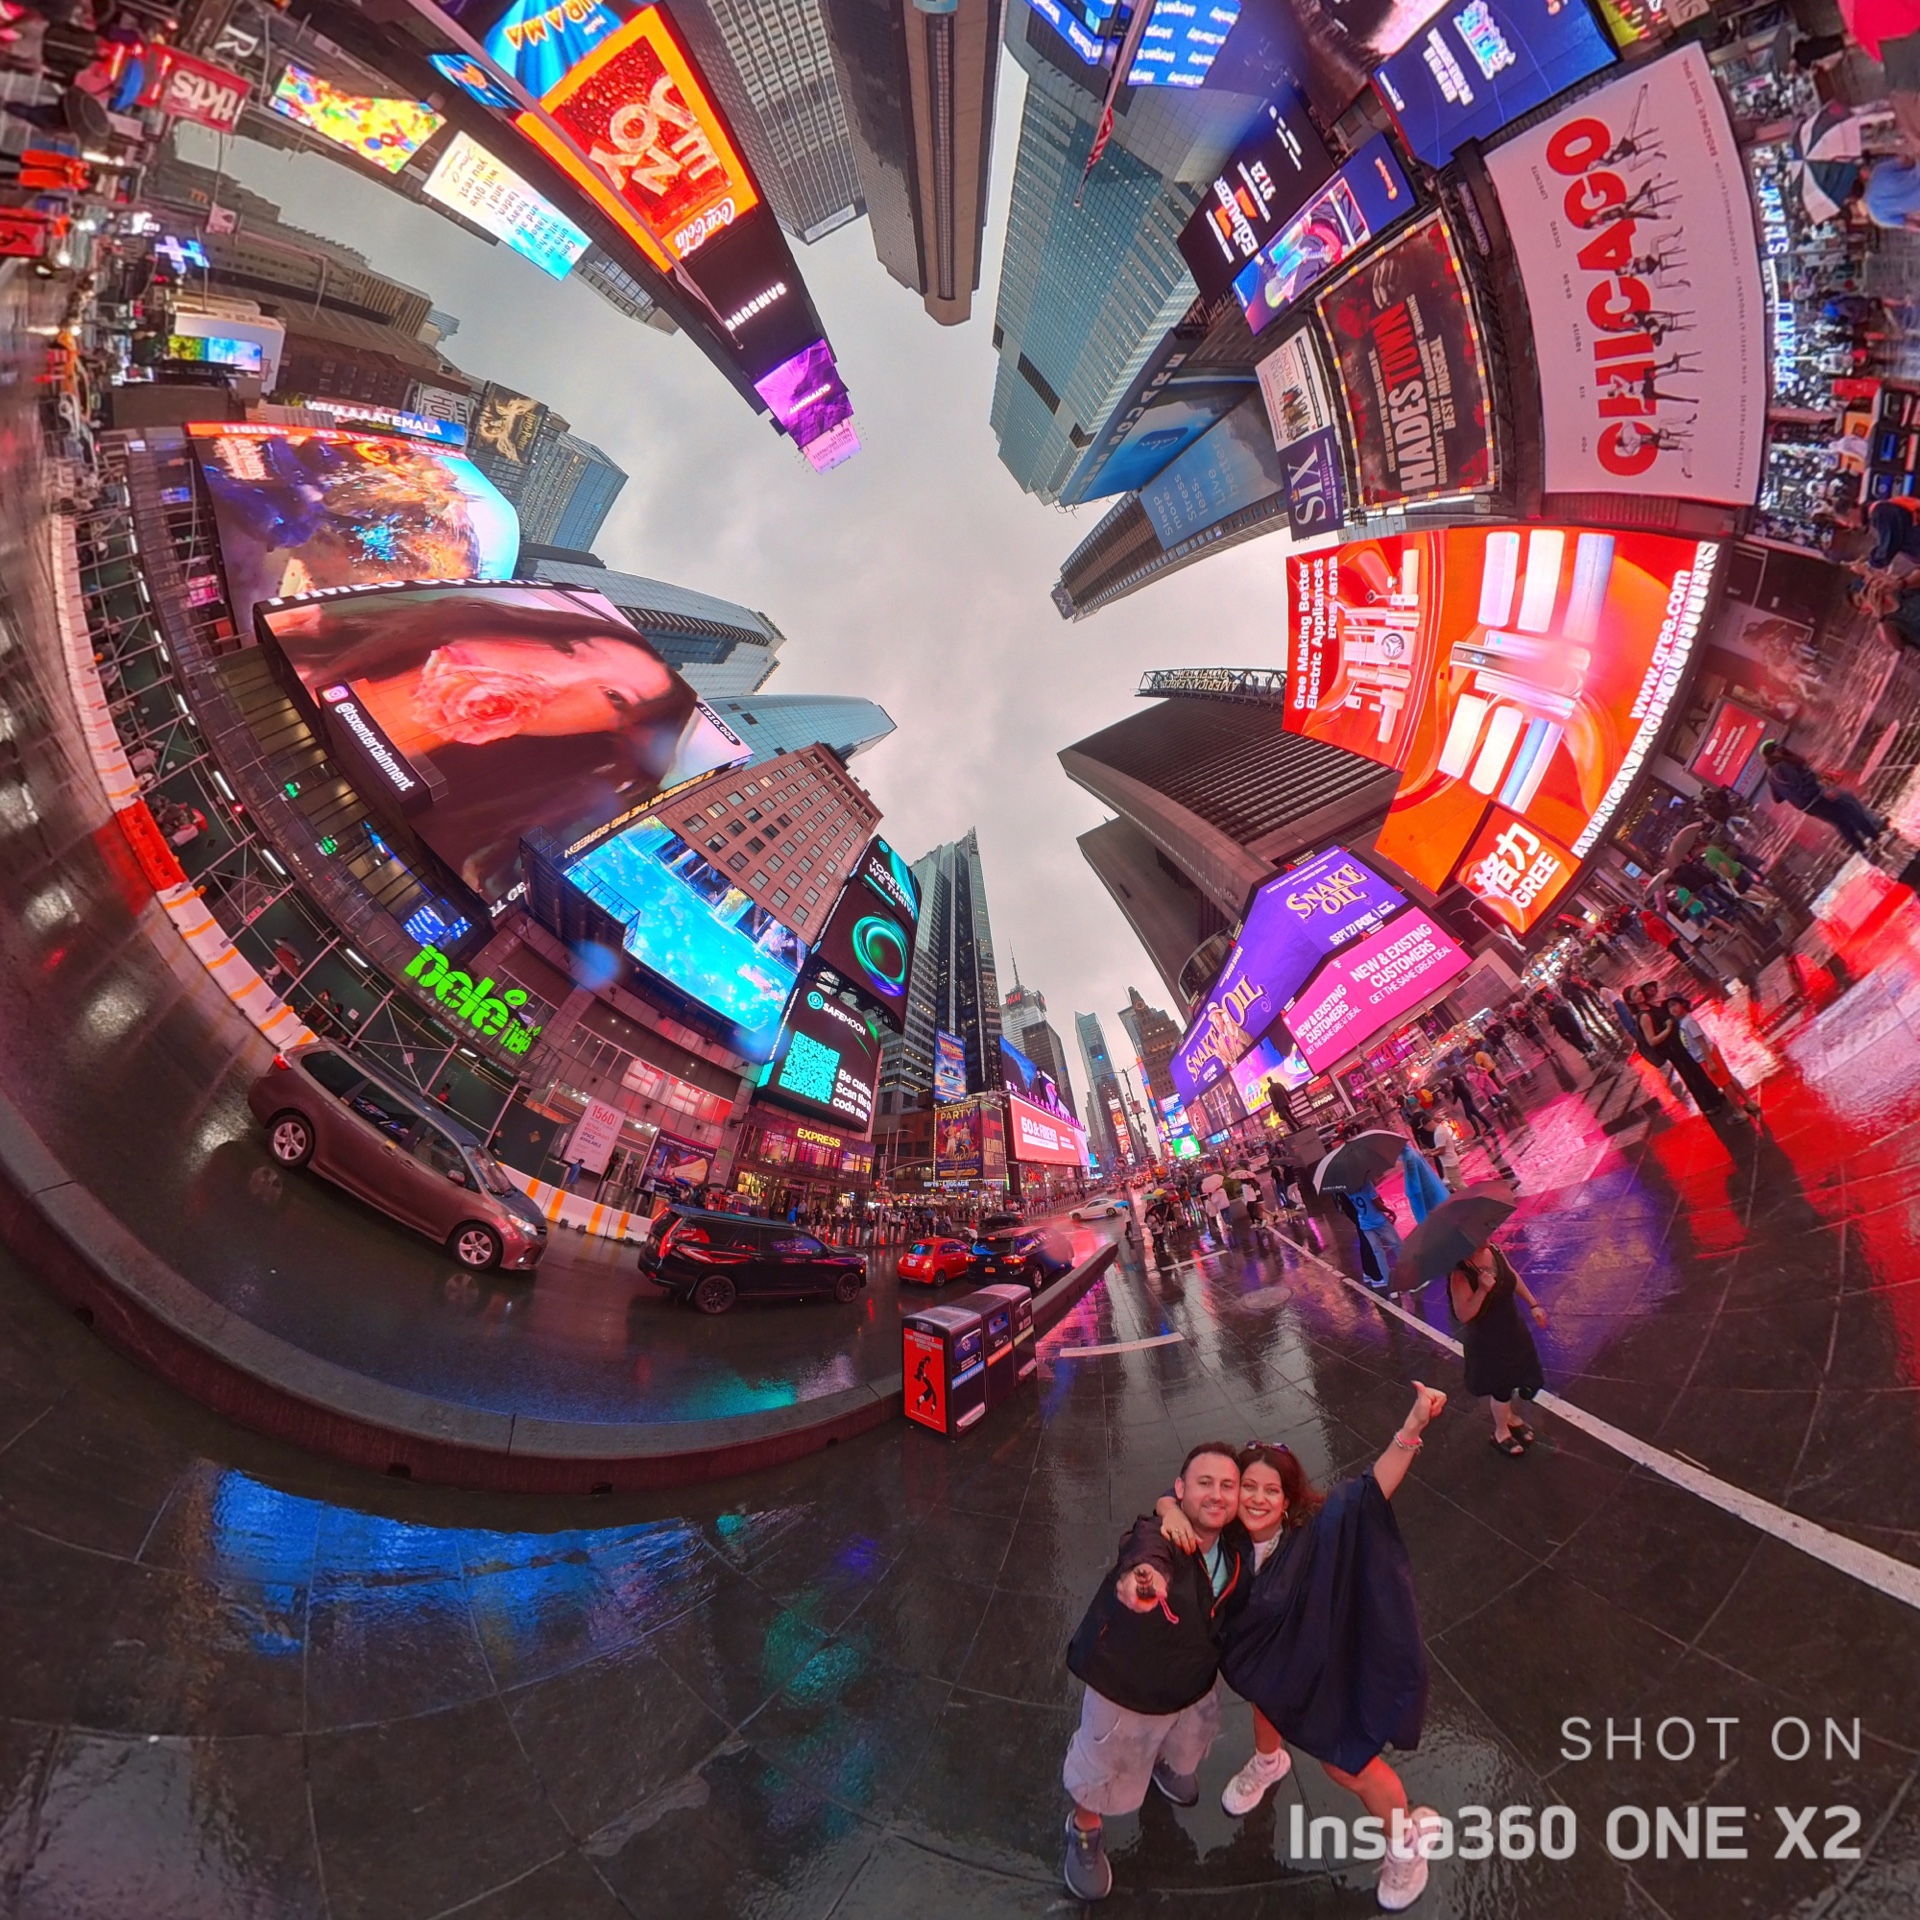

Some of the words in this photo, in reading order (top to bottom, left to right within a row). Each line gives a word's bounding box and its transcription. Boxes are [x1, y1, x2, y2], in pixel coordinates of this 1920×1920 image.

[170, 71, 240, 122] tkts
[589, 74, 699, 191] JOY
[472, 157, 488, 177] you
[483, 170, 499, 188] will
[631, 124, 721, 197] EN
[457, 178, 475, 199] rest.
[470, 187, 487, 207] give
[490, 184, 506, 205] and
[506, 200, 530, 225] heavy
[515, 222, 529, 236] are
[527, 204, 540, 223] and
[528, 217, 549, 239] labor
[549, 222, 559, 236] all
[1213, 176, 1259, 257] EQUALIZER
[725, 282, 787, 332] SAMSUNG
[1546, 117, 1659, 477] CHICAGO
[1429, 334, 1451, 397] MUSICAL
[1370, 302, 1437, 492] HADESTOWN
[1430, 401, 1442, 426] TONY
[1440, 398, 1456, 431] BEST
[1433, 425, 1448, 485] BROADWAY'S
[1175, 474, 1196, 521] Stress
[1192, 478, 1208, 516] less.
[1209, 468, 1226, 505] Live
[1287, 446, 1326, 526] SIX
[1154, 496, 1173, 536] Sleep
[1163, 487, 1182, 530] more.
[1298, 562, 1311, 612] Better
[1311, 558, 1326, 648] Appliances
[1297, 615, 1313, 672] Making
[1629, 569, 1693, 720] www.gree.com
[1293, 675, 1307, 710] Gree
[1306, 651, 1323, 710] Electric
[1570, 754, 1640, 858] AMERICAN
[1630, 696, 1671, 758] EAGLE
[1661, 540, 1721, 696] OUTFITTERS
[335, 702, 415, 792] @tsxentertainment
[610, 812, 631, 829] BIG
[630, 803, 650, 819] THE
[564, 824, 610, 859] SCREEN
[1474, 823, 1540, 899] 格力
[869, 864, 885, 884] WE
[885, 882, 916, 920] THRIVE
[871, 857, 916, 907] TOGETHER
[1286, 863, 1368, 920] SNAKE
[1321, 887, 1368, 915] OIL
[1511, 851, 1561, 909] GREE
[1329, 929, 1350, 945] SEPT
[1353, 912, 1379, 930] FOX
[1349, 957, 1381, 982] NEW
[1377, 953, 1391, 965] &
[1384, 923, 1433, 960] EXISTING
[1369, 990, 1385, 1004] GET
[1383, 980, 1401, 995] THE
[1396, 971, 1418, 987] SAME
[1414, 956, 1436, 974] GREAT
[1434, 945, 1453, 961] DEAL
[1370, 939, 1437, 988] CUSTOMERS
[822, 1002, 866, 1036] SAFEMOON
[1221, 974, 1264, 1026] OIL
[1295, 1019, 1312, 1039] NEW
[1308, 1015, 1318, 1026] &
[1313, 983, 1347, 1021] EXISTING
[1306, 1000, 1350, 1044] CUSTOMERS
[1306, 1045, 1315, 1055] GET
[1313, 1038, 1324, 1049] THE
[1321, 1029, 1335, 1043] SAME
[1346, 1005, 1362, 1020] DEAL
[838, 1069, 851, 1082] Be
[1186, 1027, 1220, 1083] SNAKE
[591, 1105, 616, 1126] 1560
[832, 1094, 855, 1114] code
[836, 1083, 857, 1100] Scan
[854, 1090, 867, 1106] the
[940, 1107, 975, 1121] PARTY!
[1312, 1094, 1334, 1108] SEPHORA
[797, 1127, 841, 1148] EXPRESS
